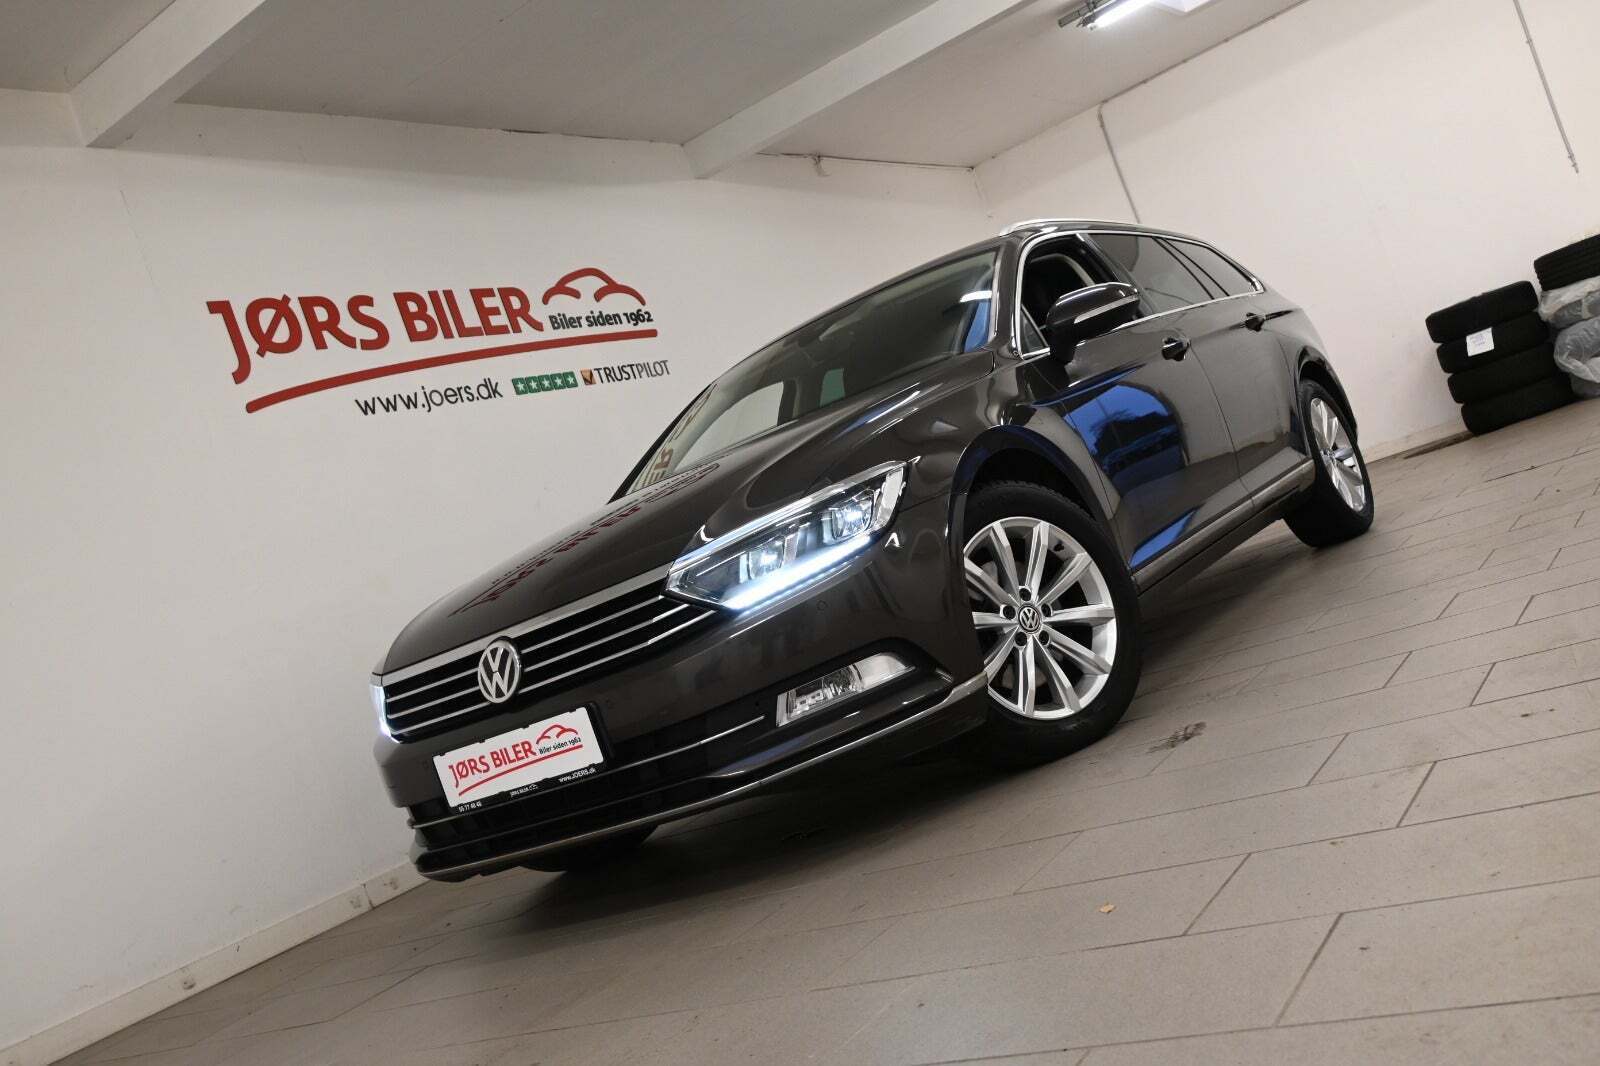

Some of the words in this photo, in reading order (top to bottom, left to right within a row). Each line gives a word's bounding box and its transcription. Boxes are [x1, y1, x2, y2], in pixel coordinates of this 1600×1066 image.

[206, 294, 390, 385] JØRS
[393, 287, 544, 343] BILER
[548, 314, 584, 331] Biler
[585, 311, 622, 327] siden
[623, 310, 654, 326] 1962
[593, 360, 671, 384] TRUSTPILOT
[354, 378, 503, 417] www.joers.dk
[538, 746, 552, 755] Biler
[552, 742, 569, 751] siden
[448, 755, 490, 789] JØRS
[489, 740, 537, 769] BILER
